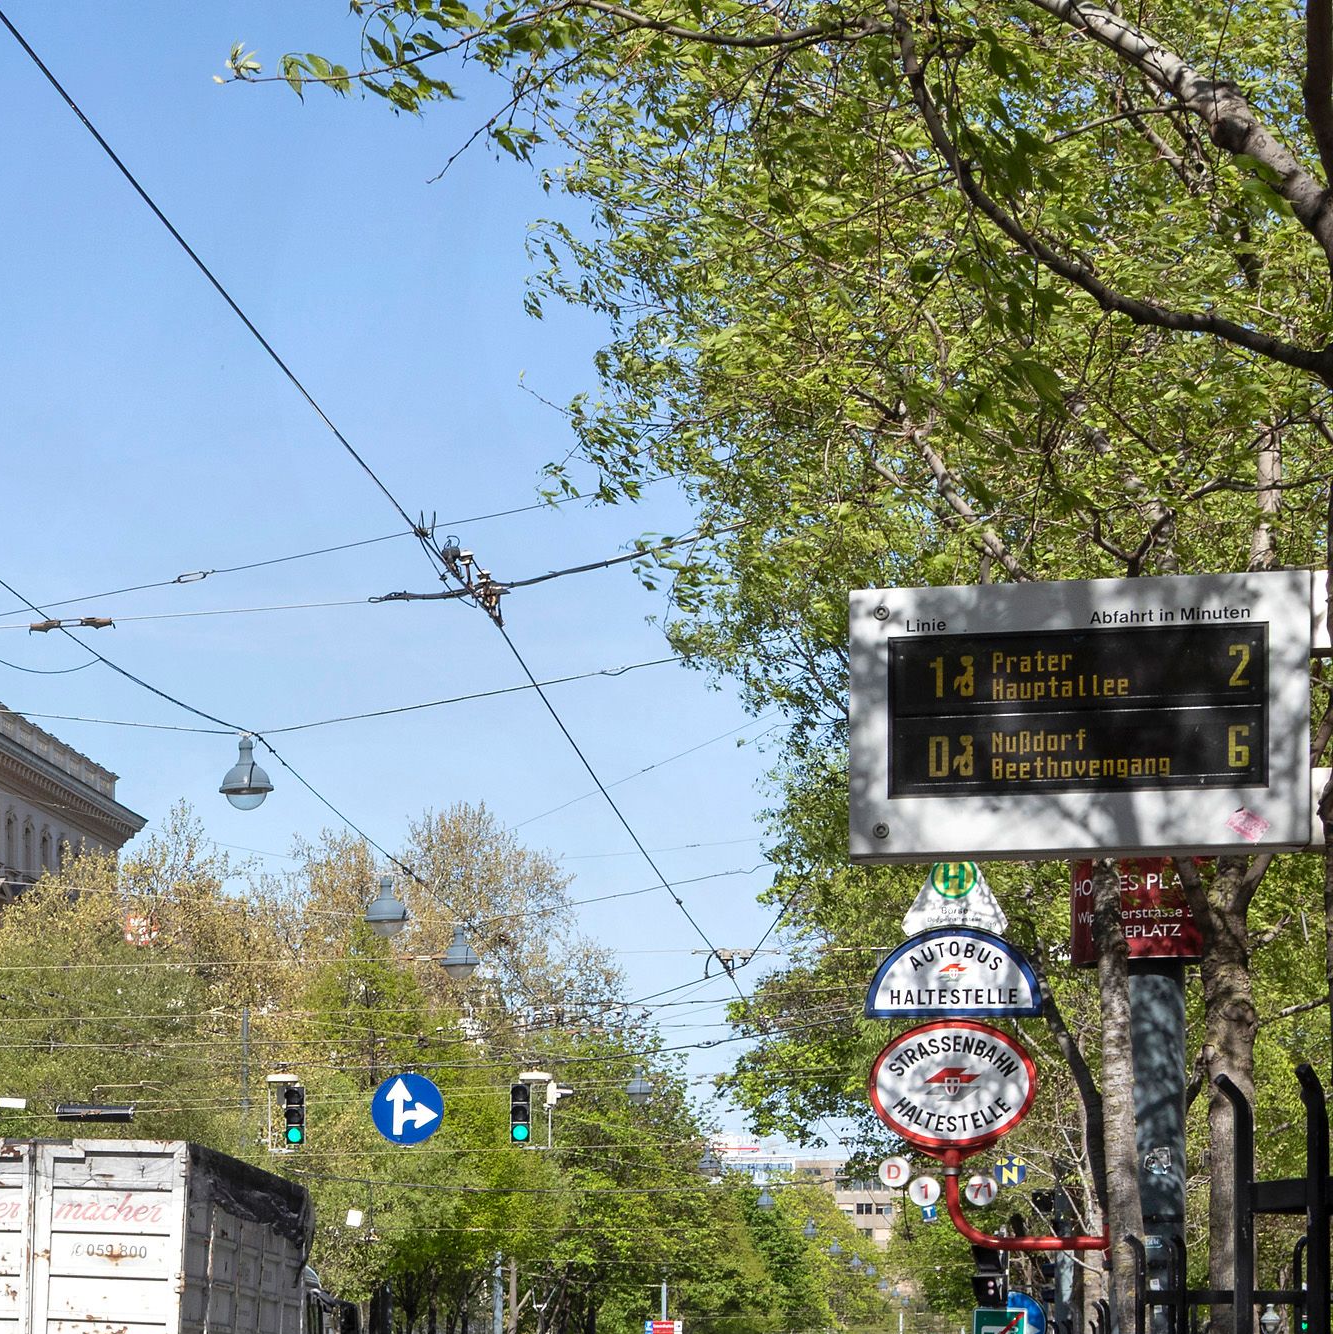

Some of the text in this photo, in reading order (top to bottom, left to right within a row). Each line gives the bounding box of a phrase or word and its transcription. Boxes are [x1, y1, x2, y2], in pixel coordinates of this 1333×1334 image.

[906, 619, 947, 633] Linie
[1090, 606, 1251, 625] Abfahrt in Minuten
[991, 651, 1073, 674] Prater
[1228, 644, 1251, 687] 2
[930, 656, 944, 698] 1
[991, 675, 1130, 701] Hauptallee
[991, 729, 1087, 755] Nußdorf
[1227, 725, 1250, 768] 6
[991, 756, 1172, 780] Beethovengang
[1074, 873, 1140, 898] HOES
[1078, 907, 1183, 927] Wiperstrasse
[909, 941, 1003, 972] AUTOBUS
[890, 988, 1019, 1005] HALTESTELLE
[888, 1035, 1019, 1078] STRASSENBAHN
[892, 1096, 1013, 1133] HALTESTELLE
[887, 1164, 902, 1180] D
[1002, 1166, 1019, 1185] N
[920, 1183, 929, 1200] 1
[970, 1182, 993, 1200] 71
[54, 1192, 165, 1223] macher
[923, 1206, 933, 1218] T
[86, 1243, 148, 1259] 059 800
